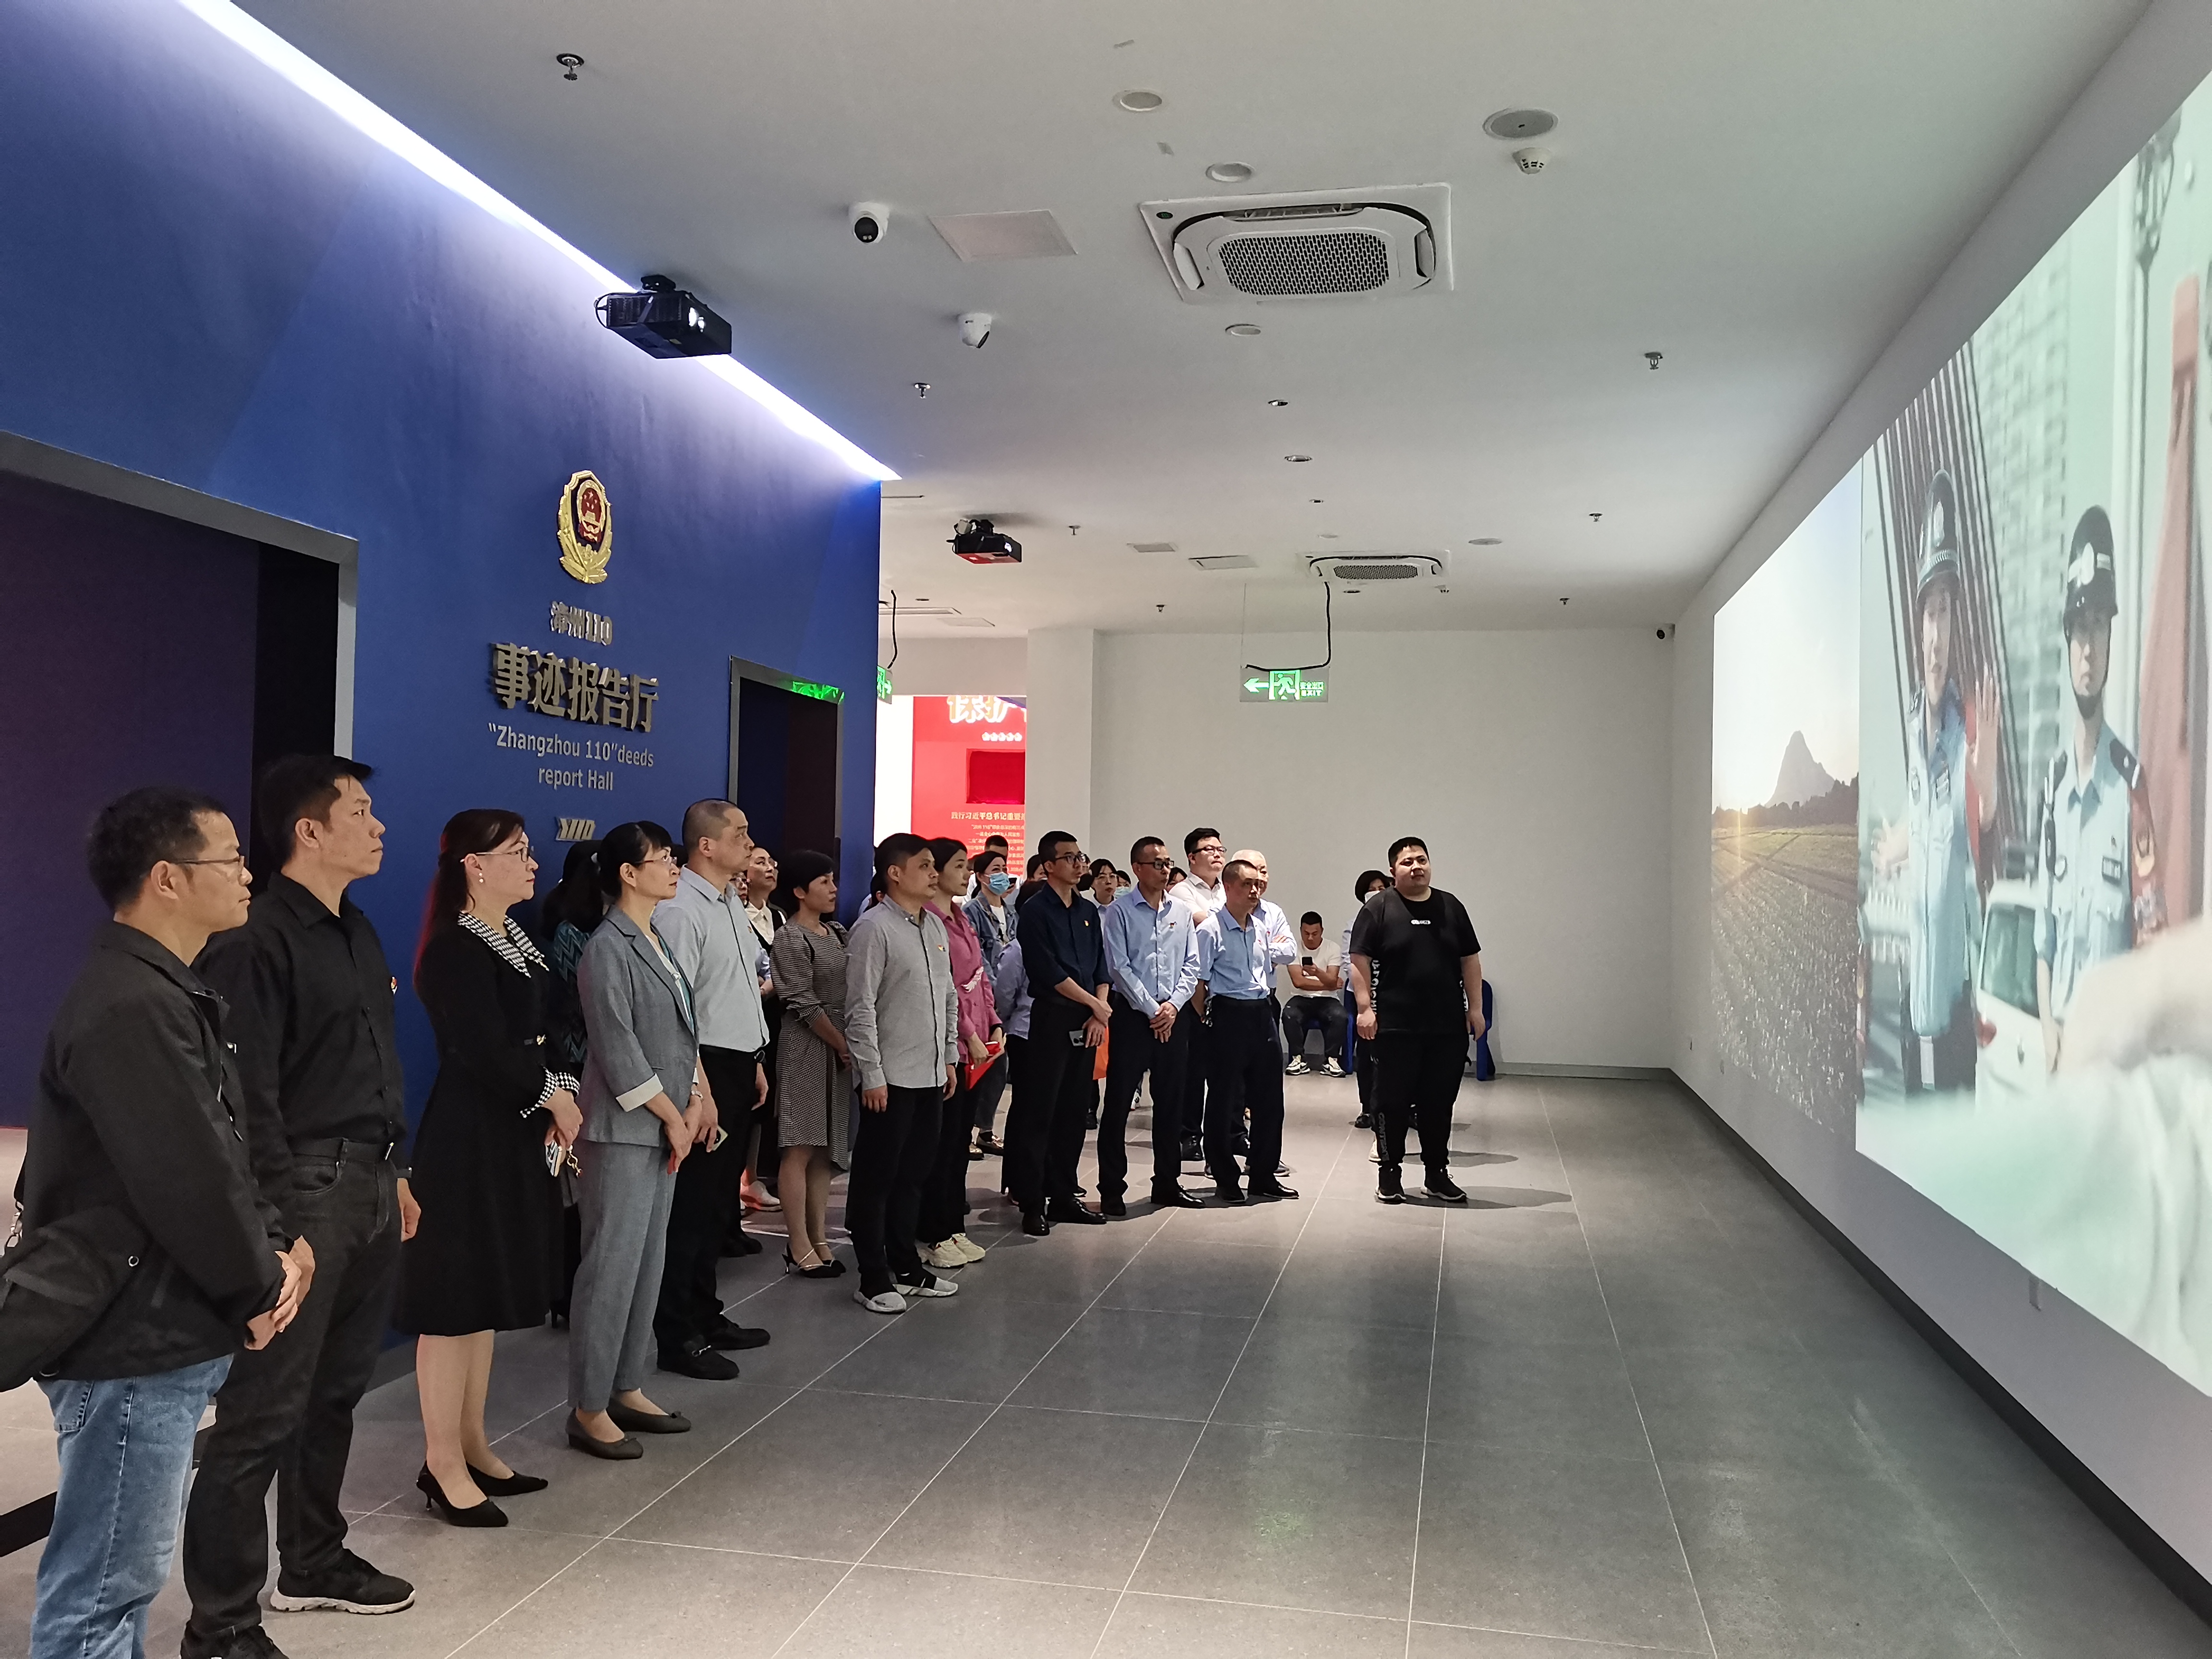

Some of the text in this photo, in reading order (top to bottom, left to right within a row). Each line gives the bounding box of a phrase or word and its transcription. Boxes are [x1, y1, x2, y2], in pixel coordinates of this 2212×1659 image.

[493, 642, 659, 733] 事迹报告厅
[539, 768, 613, 791] report Hall
